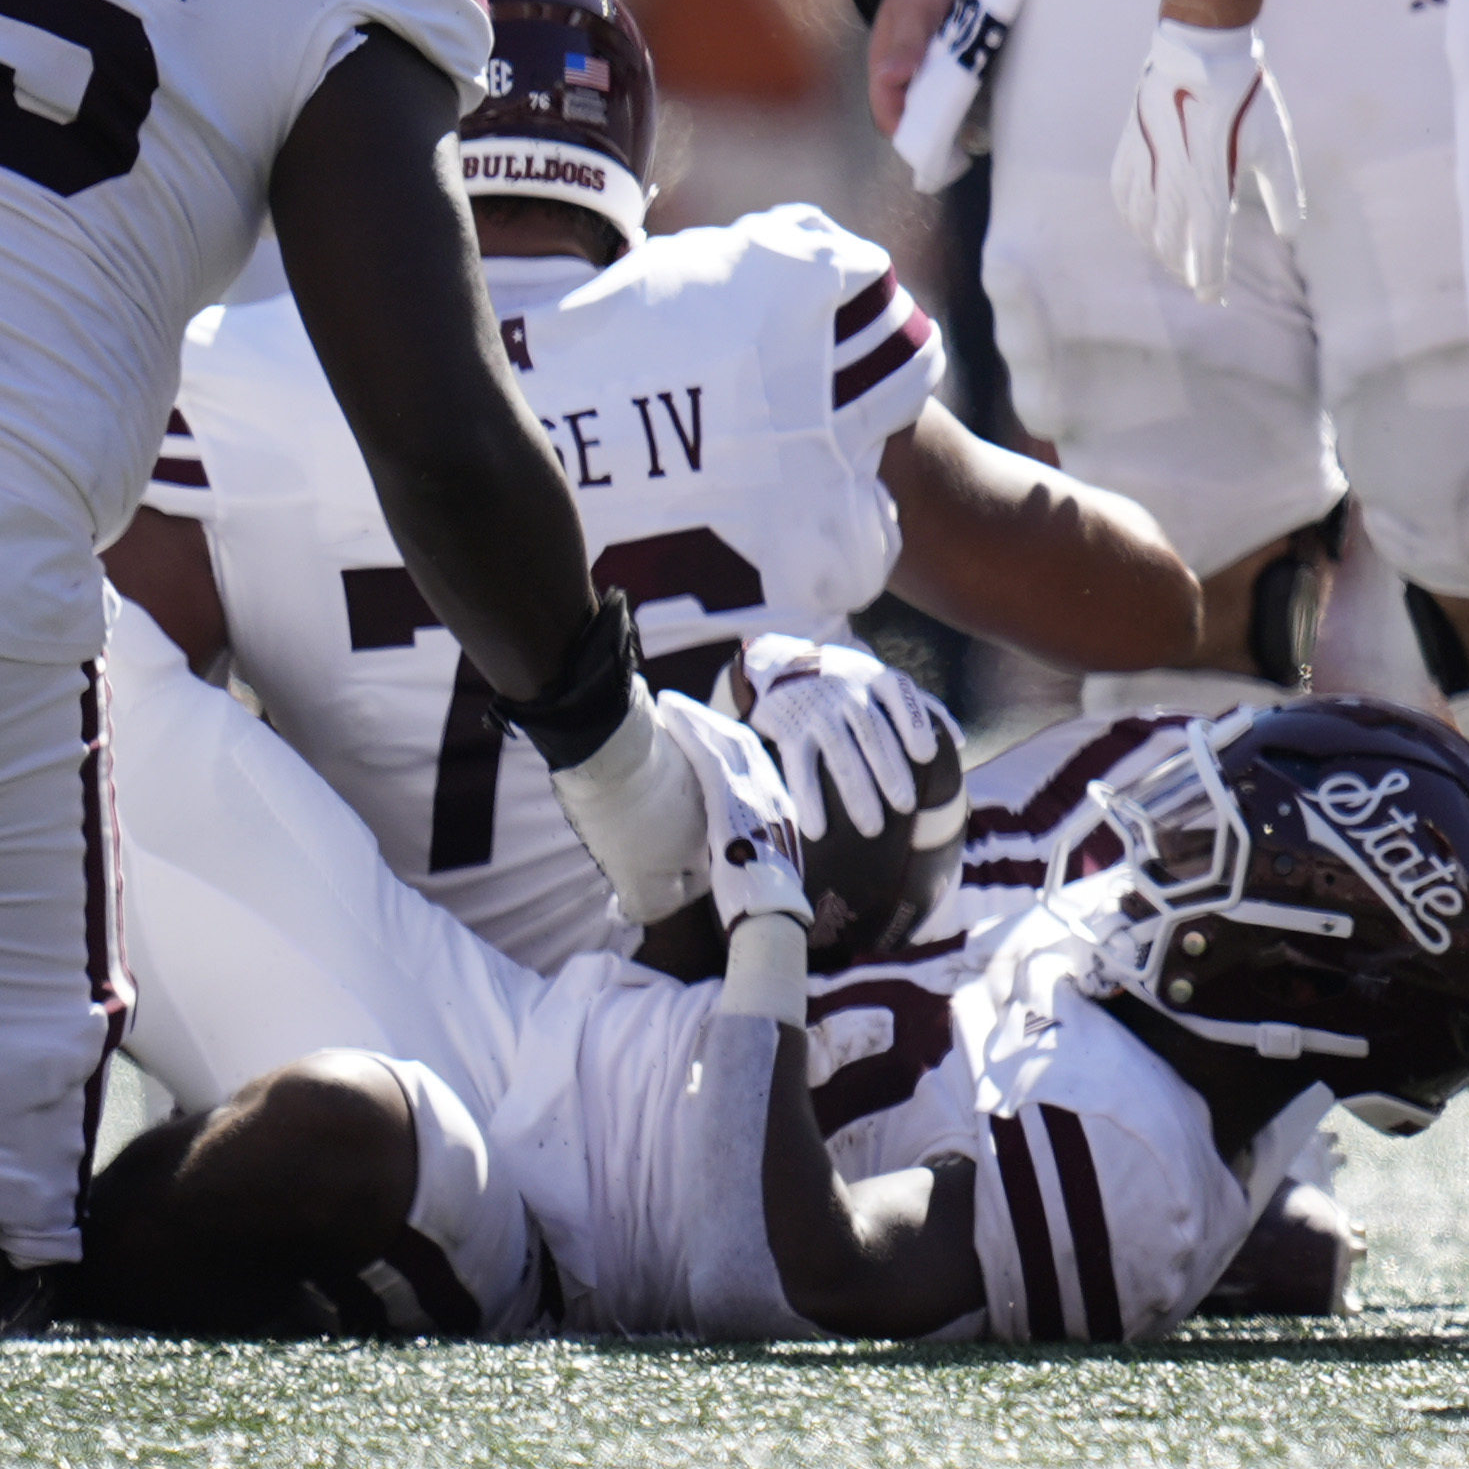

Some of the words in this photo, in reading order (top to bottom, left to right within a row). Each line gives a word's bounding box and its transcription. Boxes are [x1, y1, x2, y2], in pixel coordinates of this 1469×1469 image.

[462, 154, 607, 193] BULLDOGS
[631, 386, 702, 479] IV
[1300, 768, 1464, 932] State
